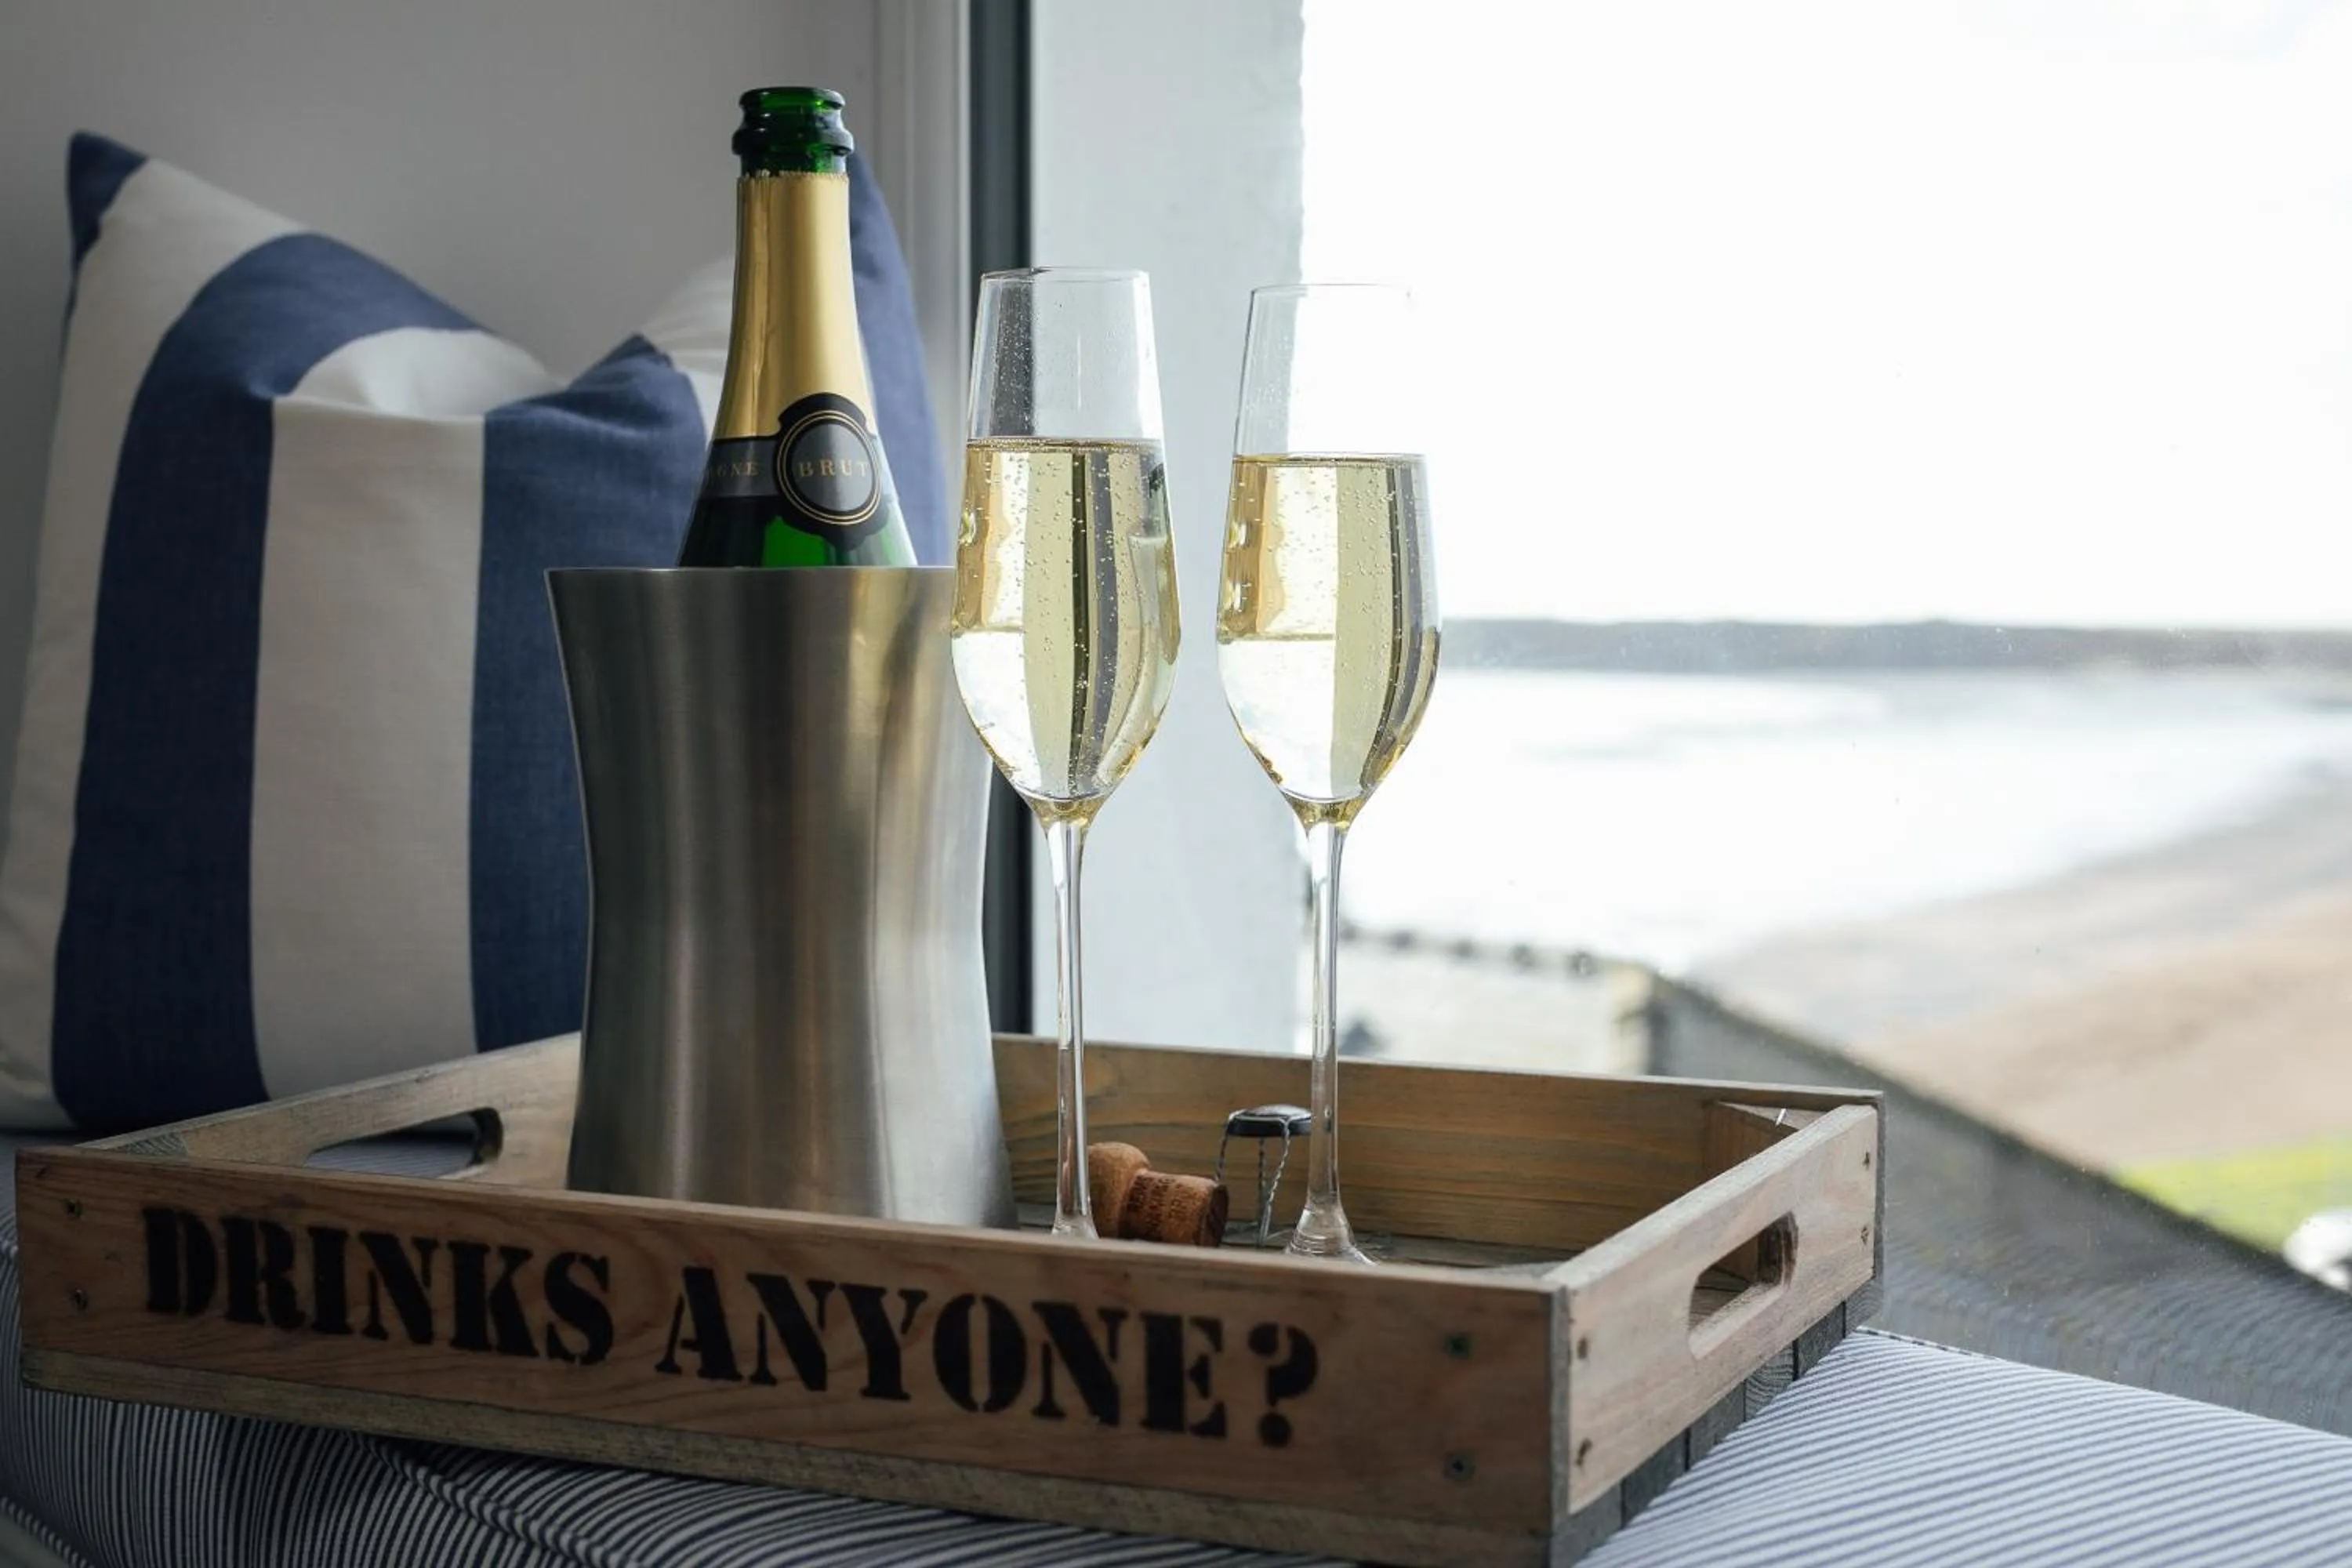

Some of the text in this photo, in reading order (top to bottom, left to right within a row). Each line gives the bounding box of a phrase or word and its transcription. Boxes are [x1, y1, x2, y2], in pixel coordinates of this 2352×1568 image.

[709, 458, 869, 481] GNE BRUT
[142, 1206, 1319, 1447] DRINKS ANYONE?
